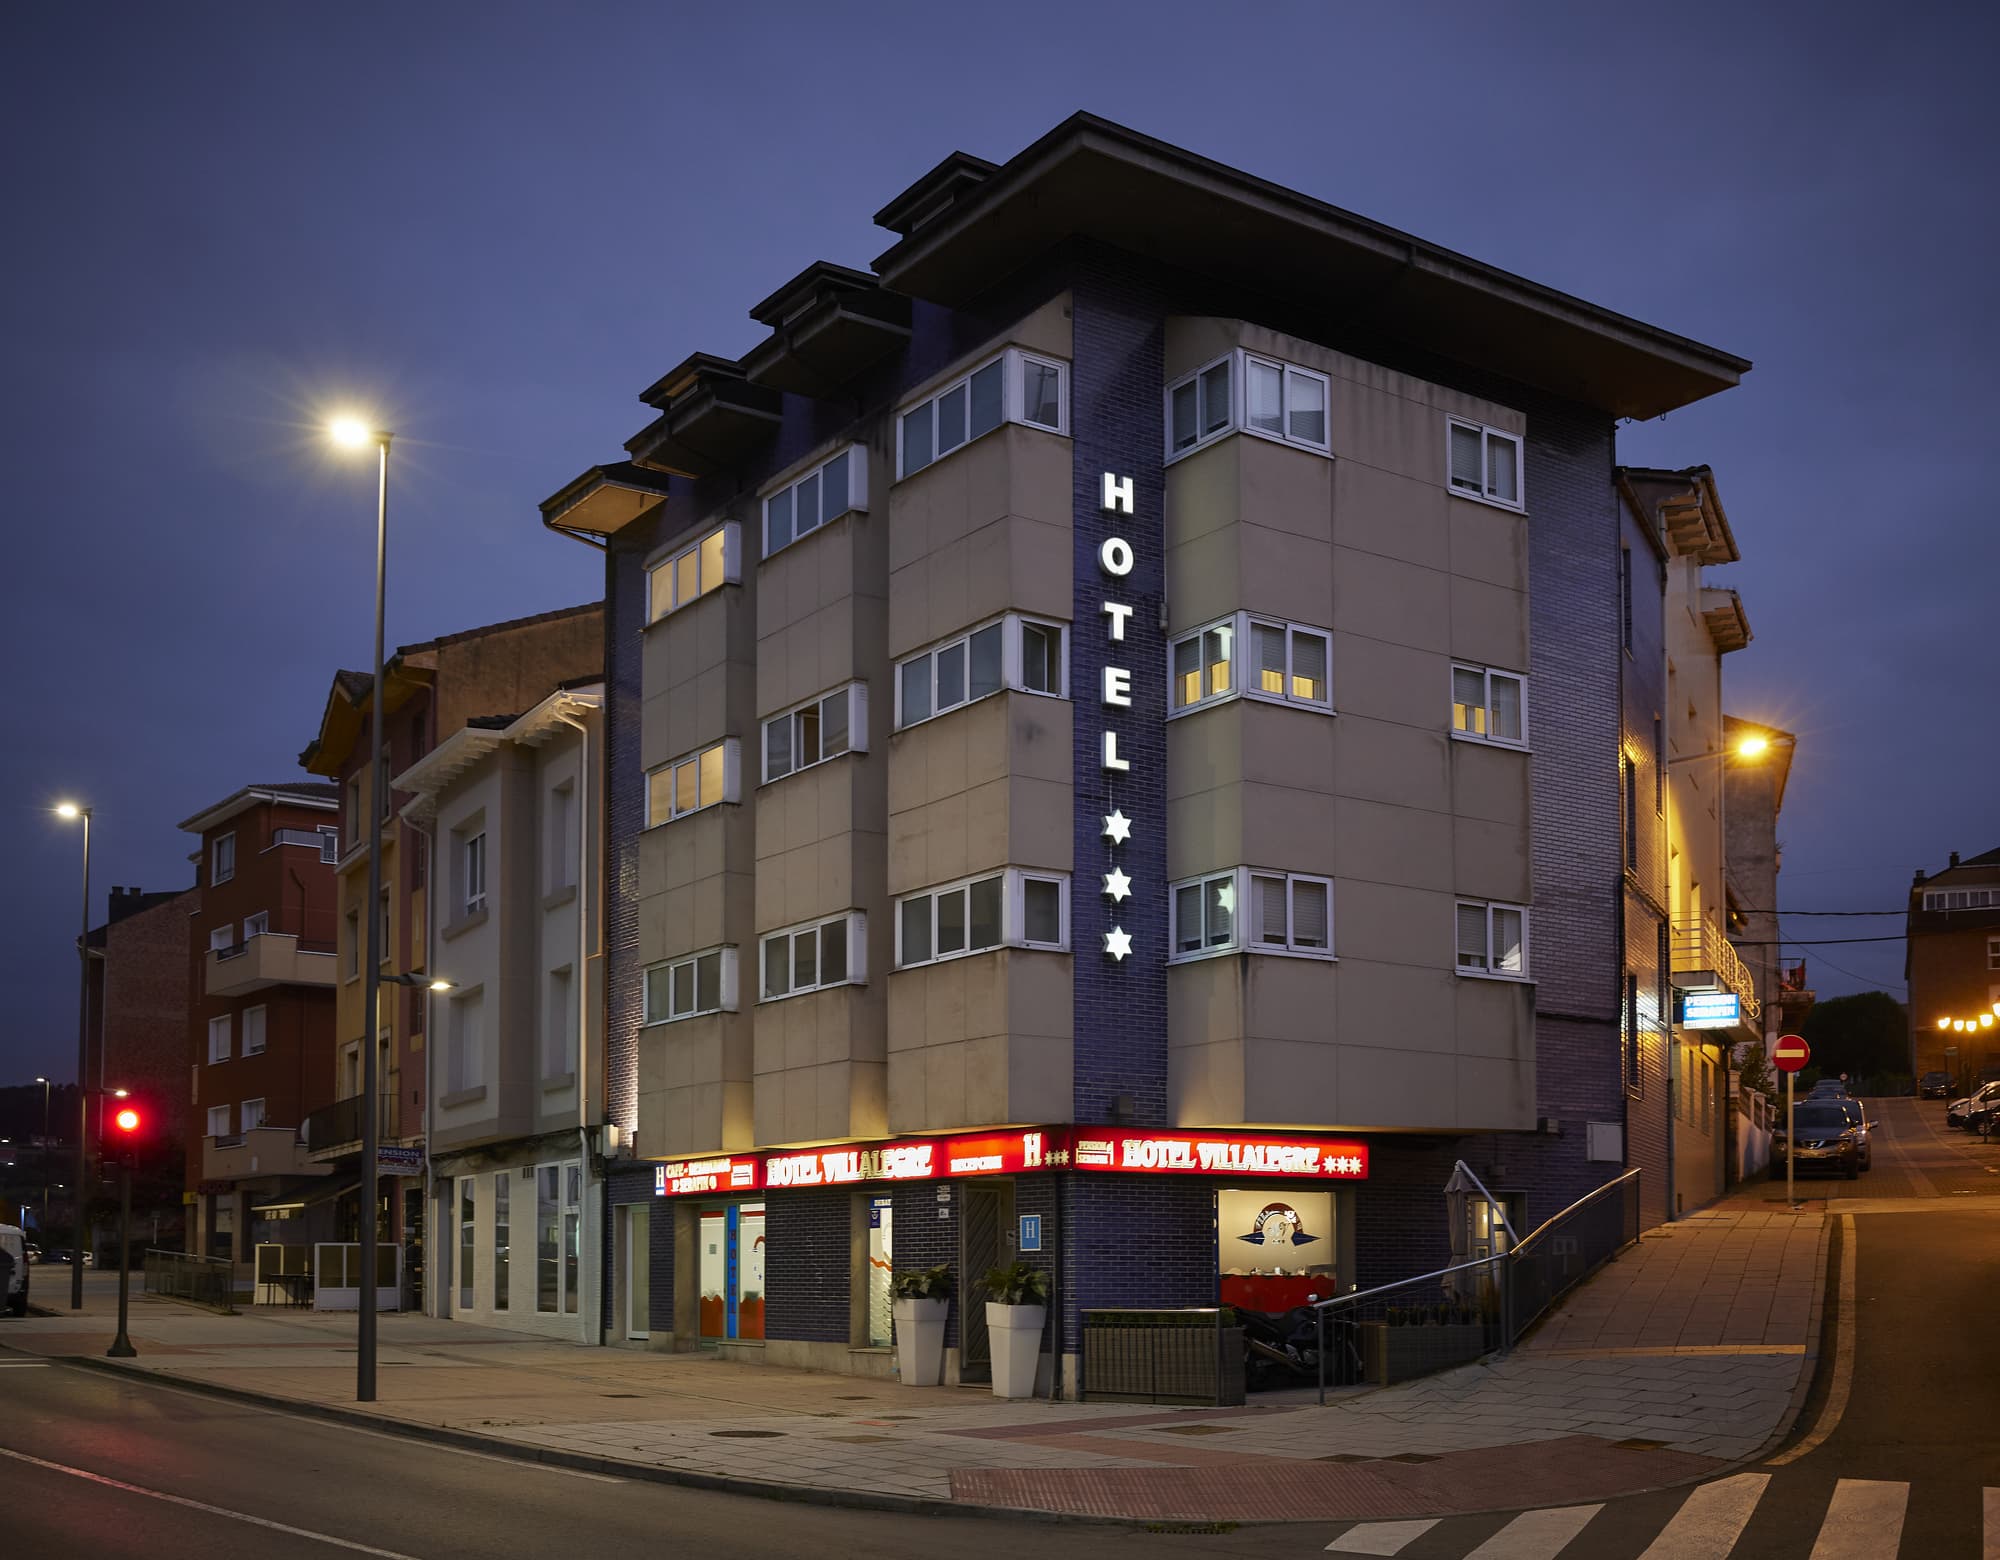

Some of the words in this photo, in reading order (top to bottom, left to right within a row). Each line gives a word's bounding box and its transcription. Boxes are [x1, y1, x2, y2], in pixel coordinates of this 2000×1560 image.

[1100, 471, 1134, 772] HOTEL
[378, 1148, 419, 1157] ENSION
[766, 1155, 822, 1185] HOTEL
[821, 1146, 932, 1182] VILLALEGRE
[1023, 1133, 1041, 1167] H
[1123, 1140, 1198, 1169] HOTEL
[1197, 1142, 1320, 1172] VILLALEGRE
[656, 1166, 664, 1187] H
[1025, 1221, 1035, 1238] H
